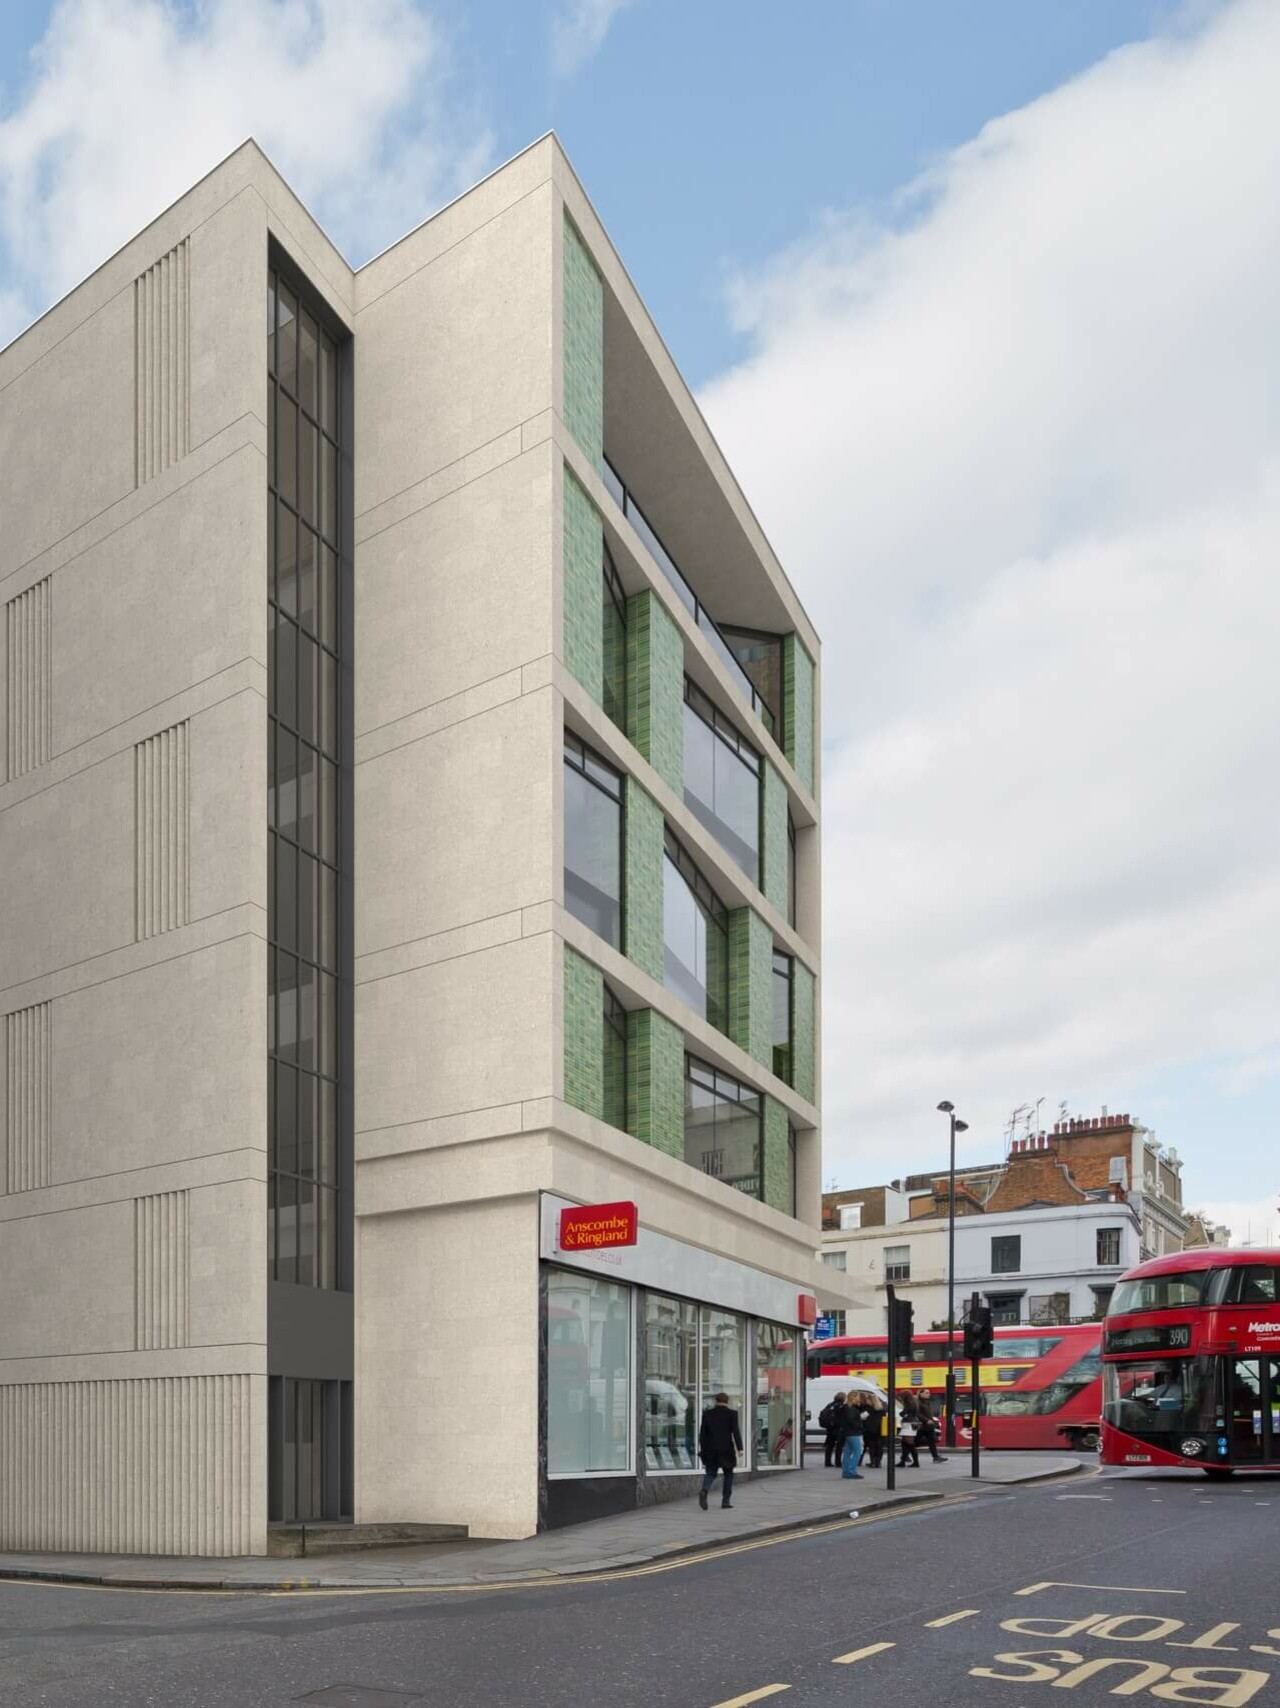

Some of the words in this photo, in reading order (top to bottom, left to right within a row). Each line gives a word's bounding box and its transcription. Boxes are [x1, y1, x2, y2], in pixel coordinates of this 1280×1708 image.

[565, 1216, 628, 1233] Anscombe
[565, 1234, 575, 1246] &
[577, 1228, 628, 1246] Ringland
[1169, 1328, 1188, 1346] 390
[968, 1650, 1270, 1707] BUS
